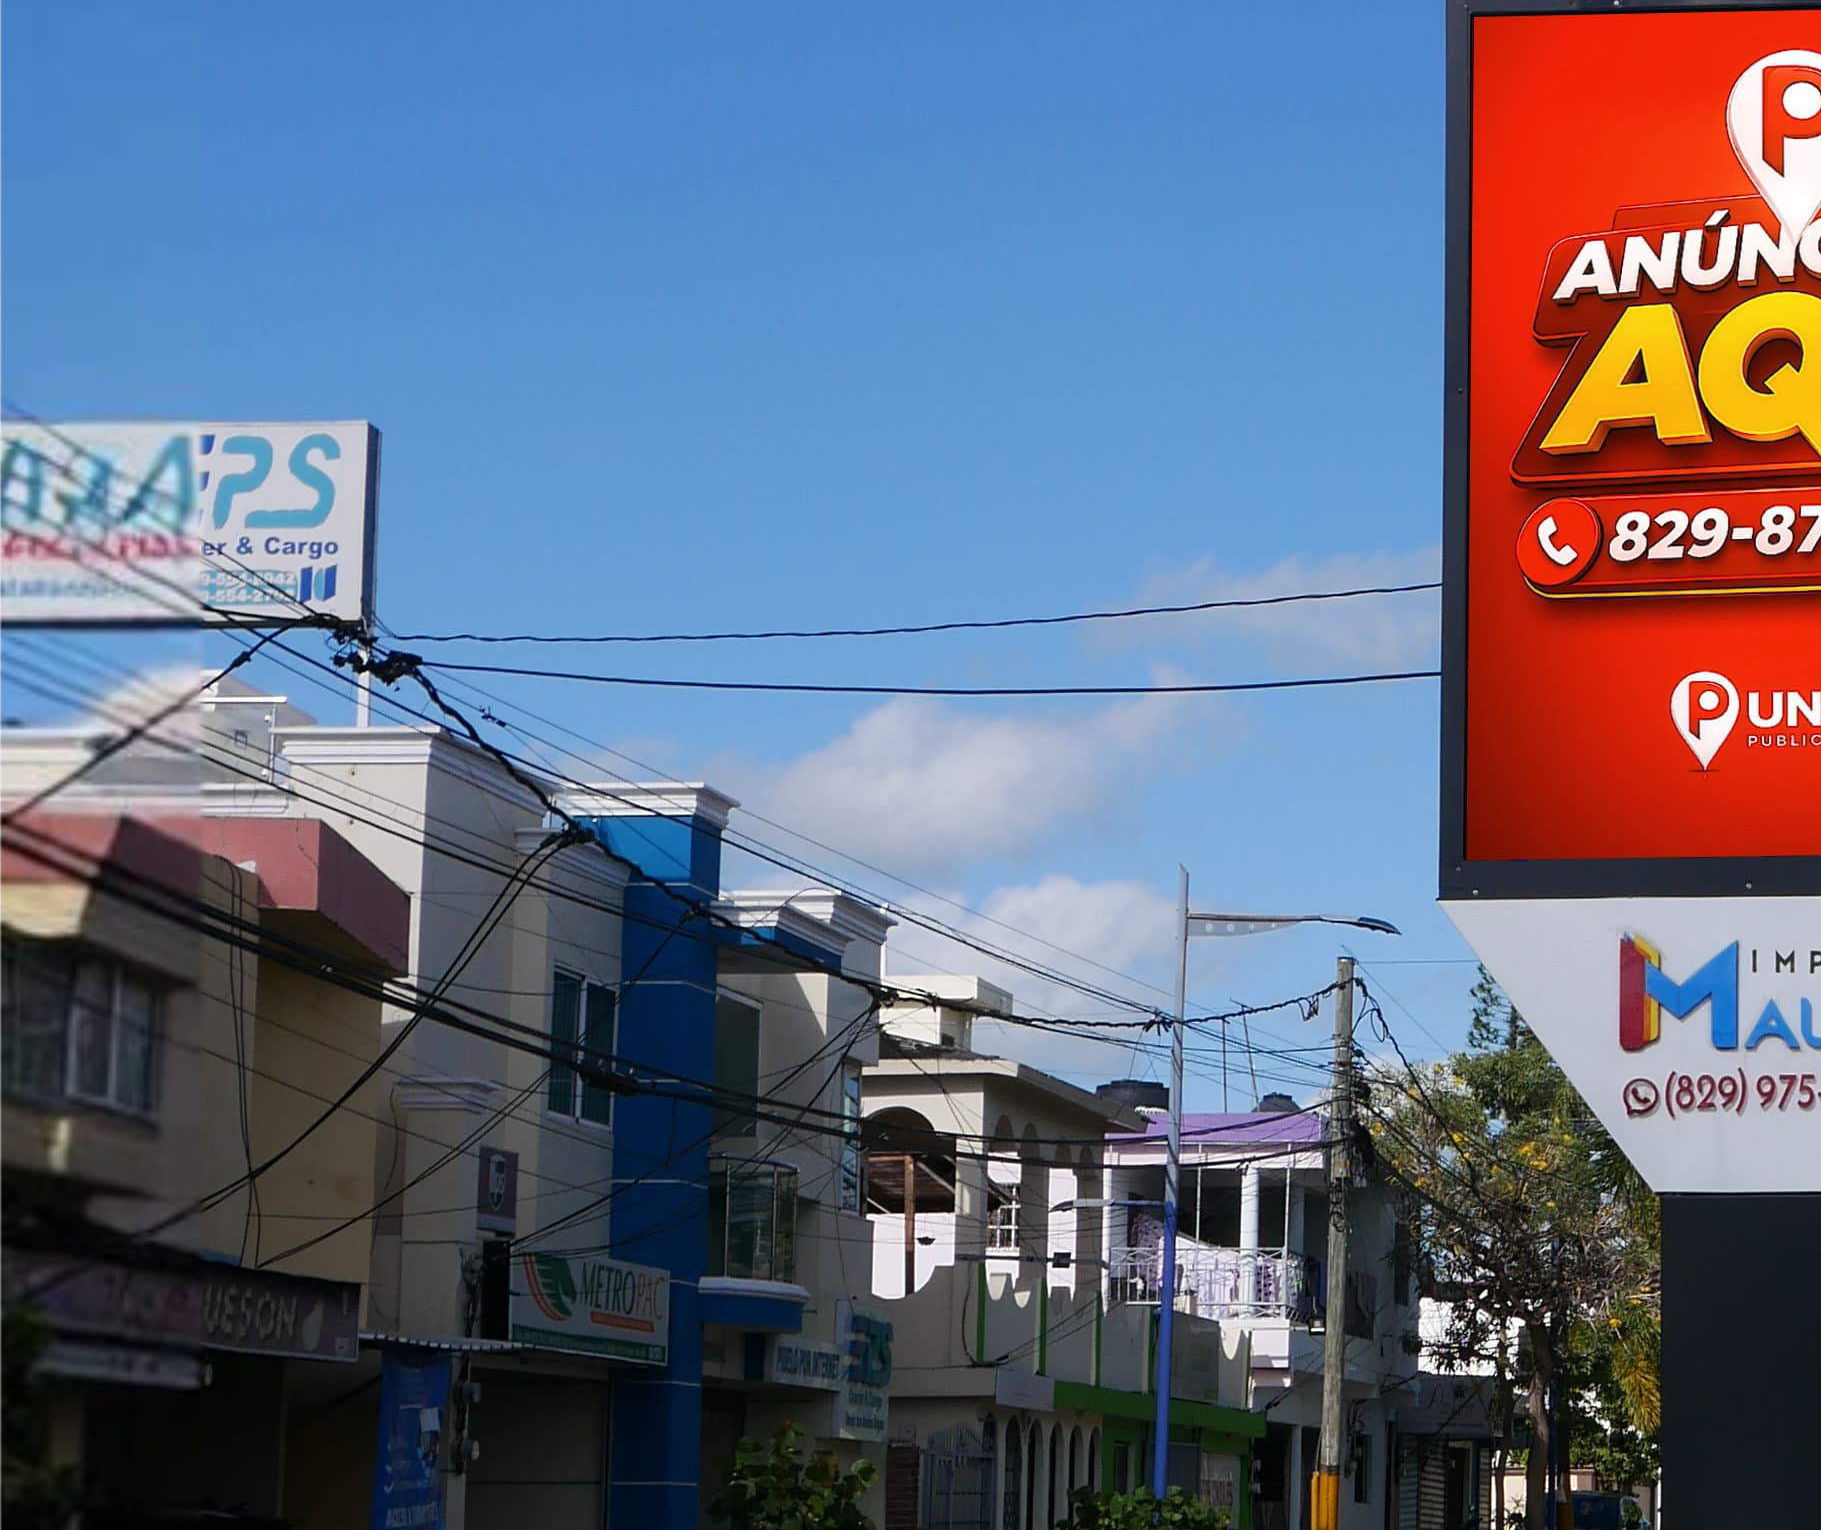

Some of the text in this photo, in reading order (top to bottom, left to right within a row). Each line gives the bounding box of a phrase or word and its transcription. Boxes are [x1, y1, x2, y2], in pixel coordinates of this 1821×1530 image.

[236, 536, 253, 555] &
[264, 536, 339, 561] Cargo
[1664, 1069, 1747, 1117] (829)
[581, 1261, 665, 1319] METROPAC
